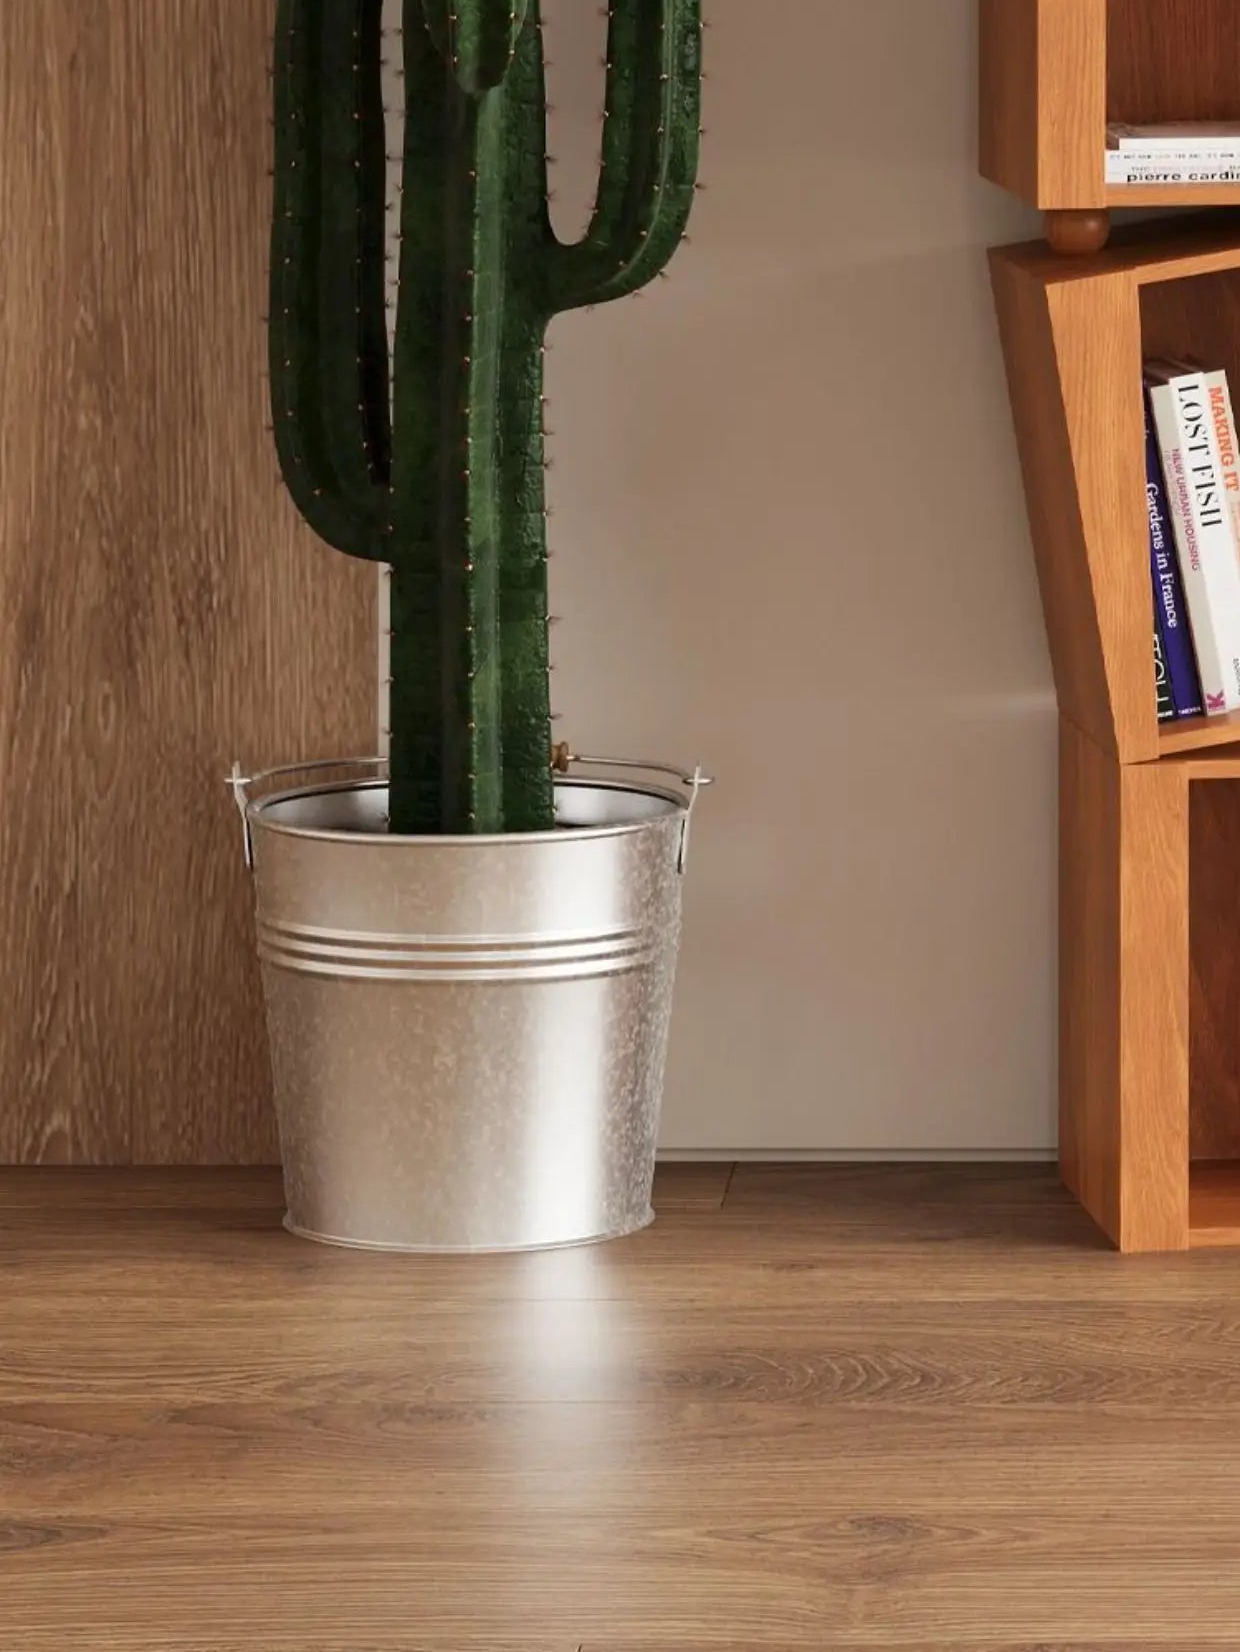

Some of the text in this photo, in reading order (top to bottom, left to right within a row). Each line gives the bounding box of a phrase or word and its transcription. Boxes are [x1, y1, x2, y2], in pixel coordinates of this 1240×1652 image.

[1127, 173, 1181, 182] pierre
[1178, 385, 1222, 526] LOST FISH
[1209, 387, 1239, 491] MAKING IT
[1147, 483, 1163, 548] Gardens
[1171, 449, 1181, 474] NEW
[1176, 477, 1191, 517] URBAN
[1184, 519, 1200, 571] HOUSING
[1157, 552, 1168, 569] in
[1160, 572, 1178, 628] France
